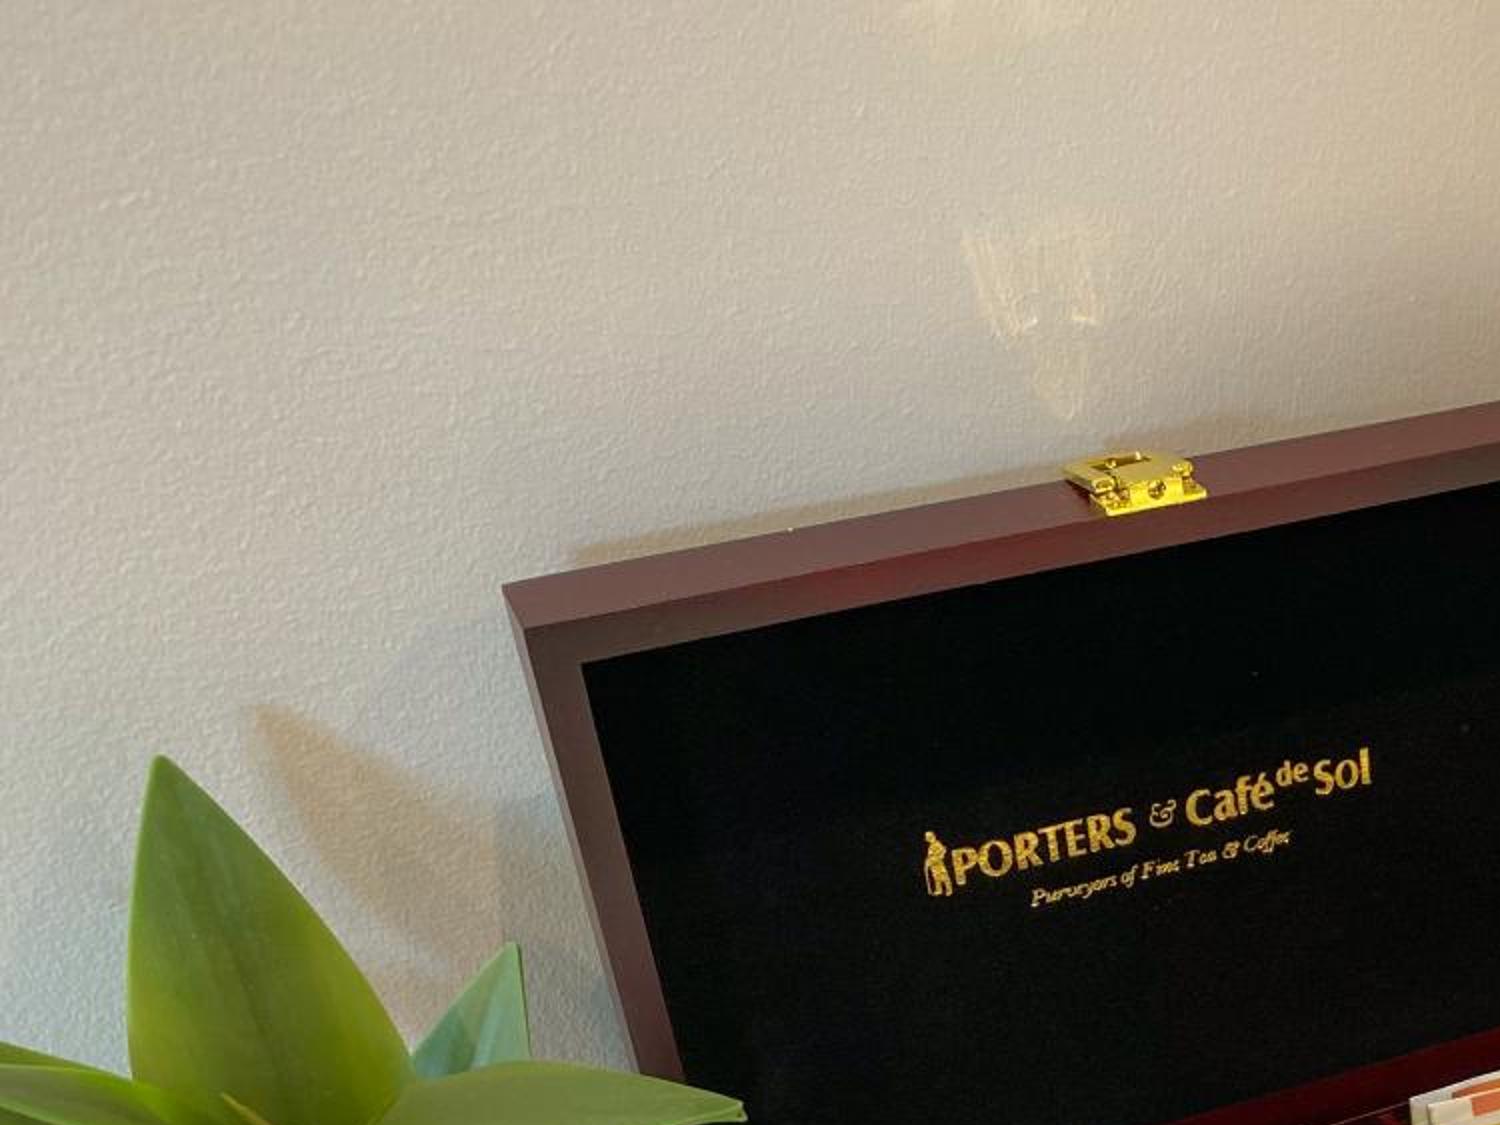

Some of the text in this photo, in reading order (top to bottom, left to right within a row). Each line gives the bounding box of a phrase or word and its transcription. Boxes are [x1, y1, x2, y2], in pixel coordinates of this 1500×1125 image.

[952, 807, 1137, 886] PORTERS
[1149, 800, 1177, 828] &
[1185, 772, 1275, 826] Café
[1276, 760, 1310, 787] de
